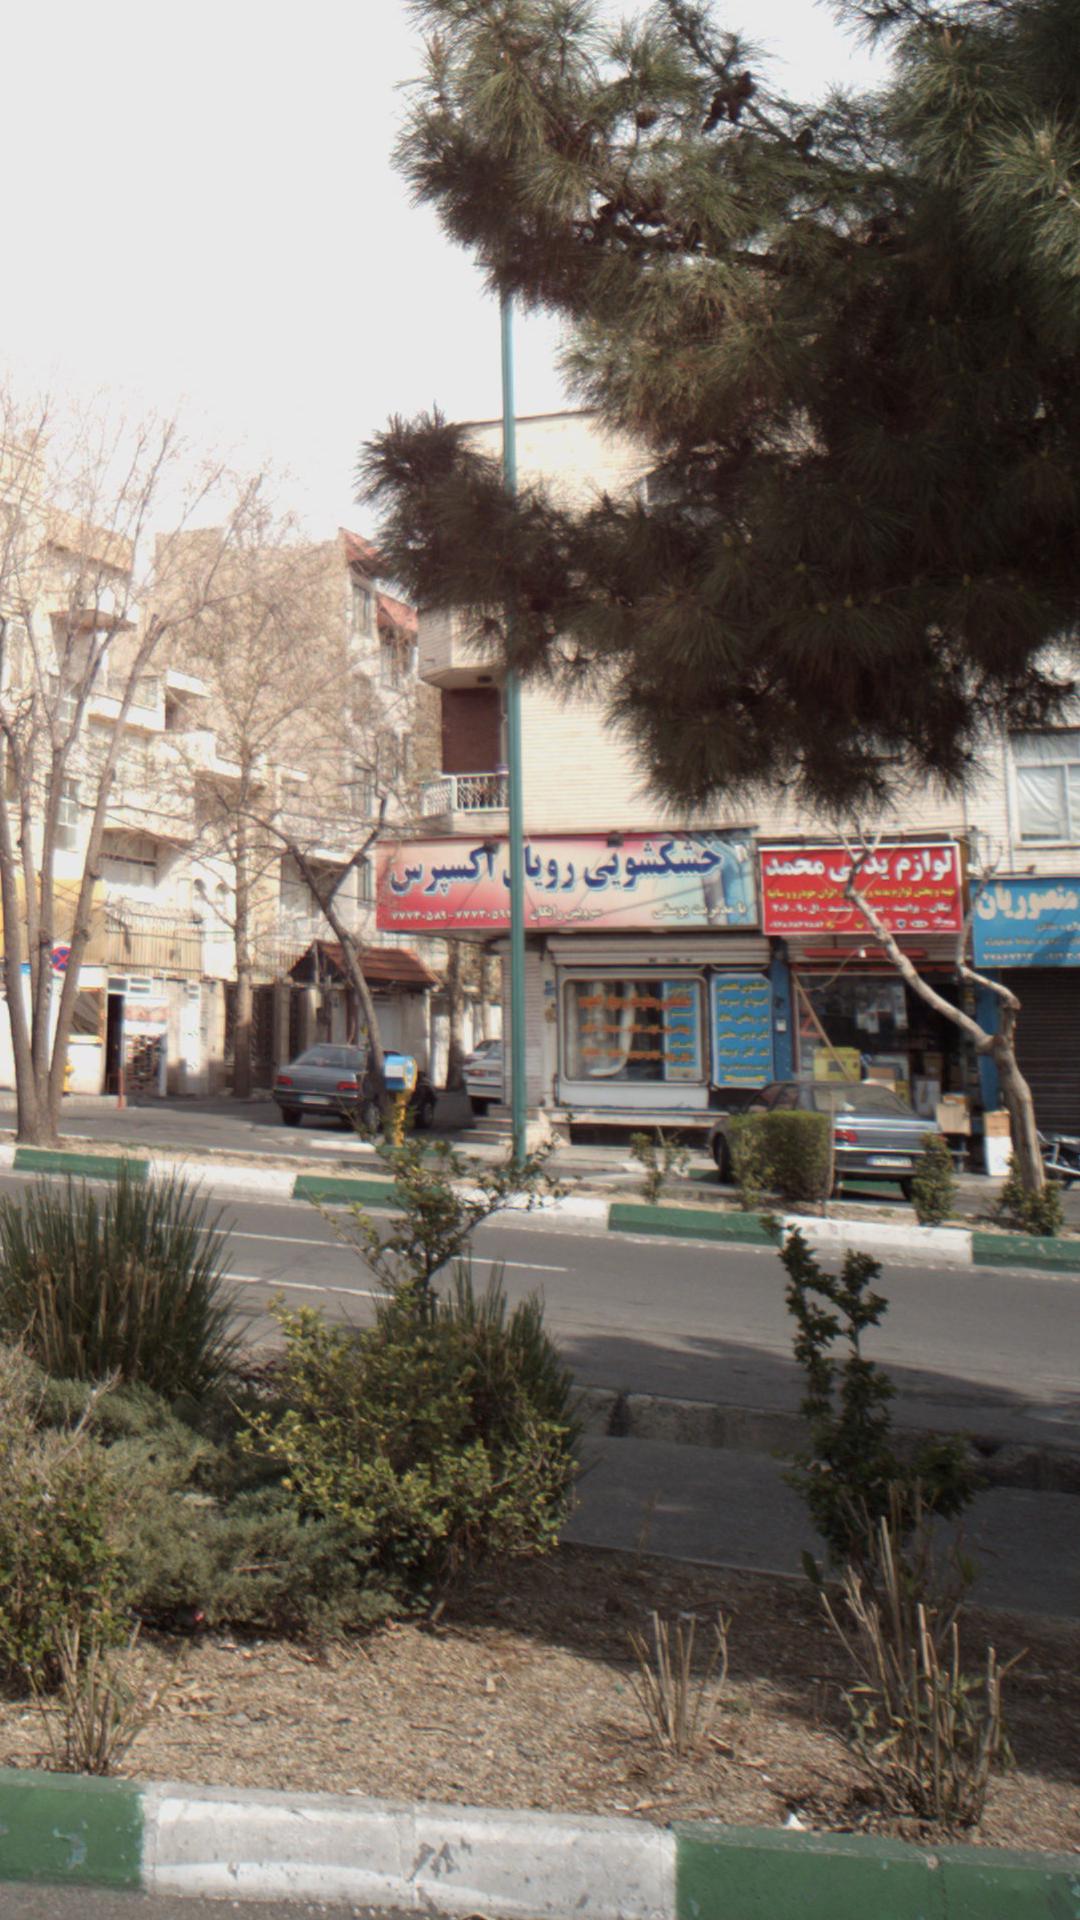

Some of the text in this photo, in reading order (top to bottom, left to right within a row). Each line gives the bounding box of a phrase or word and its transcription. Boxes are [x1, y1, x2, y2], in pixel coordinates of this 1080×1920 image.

[390, 846, 494, 892] اکسپرس
[584, 841, 721, 889] خشکشویی
[766, 858, 825, 875] محمد
[895, 850, 951, 881] لوازم
[977, 883, 1077, 920] منصوریان
